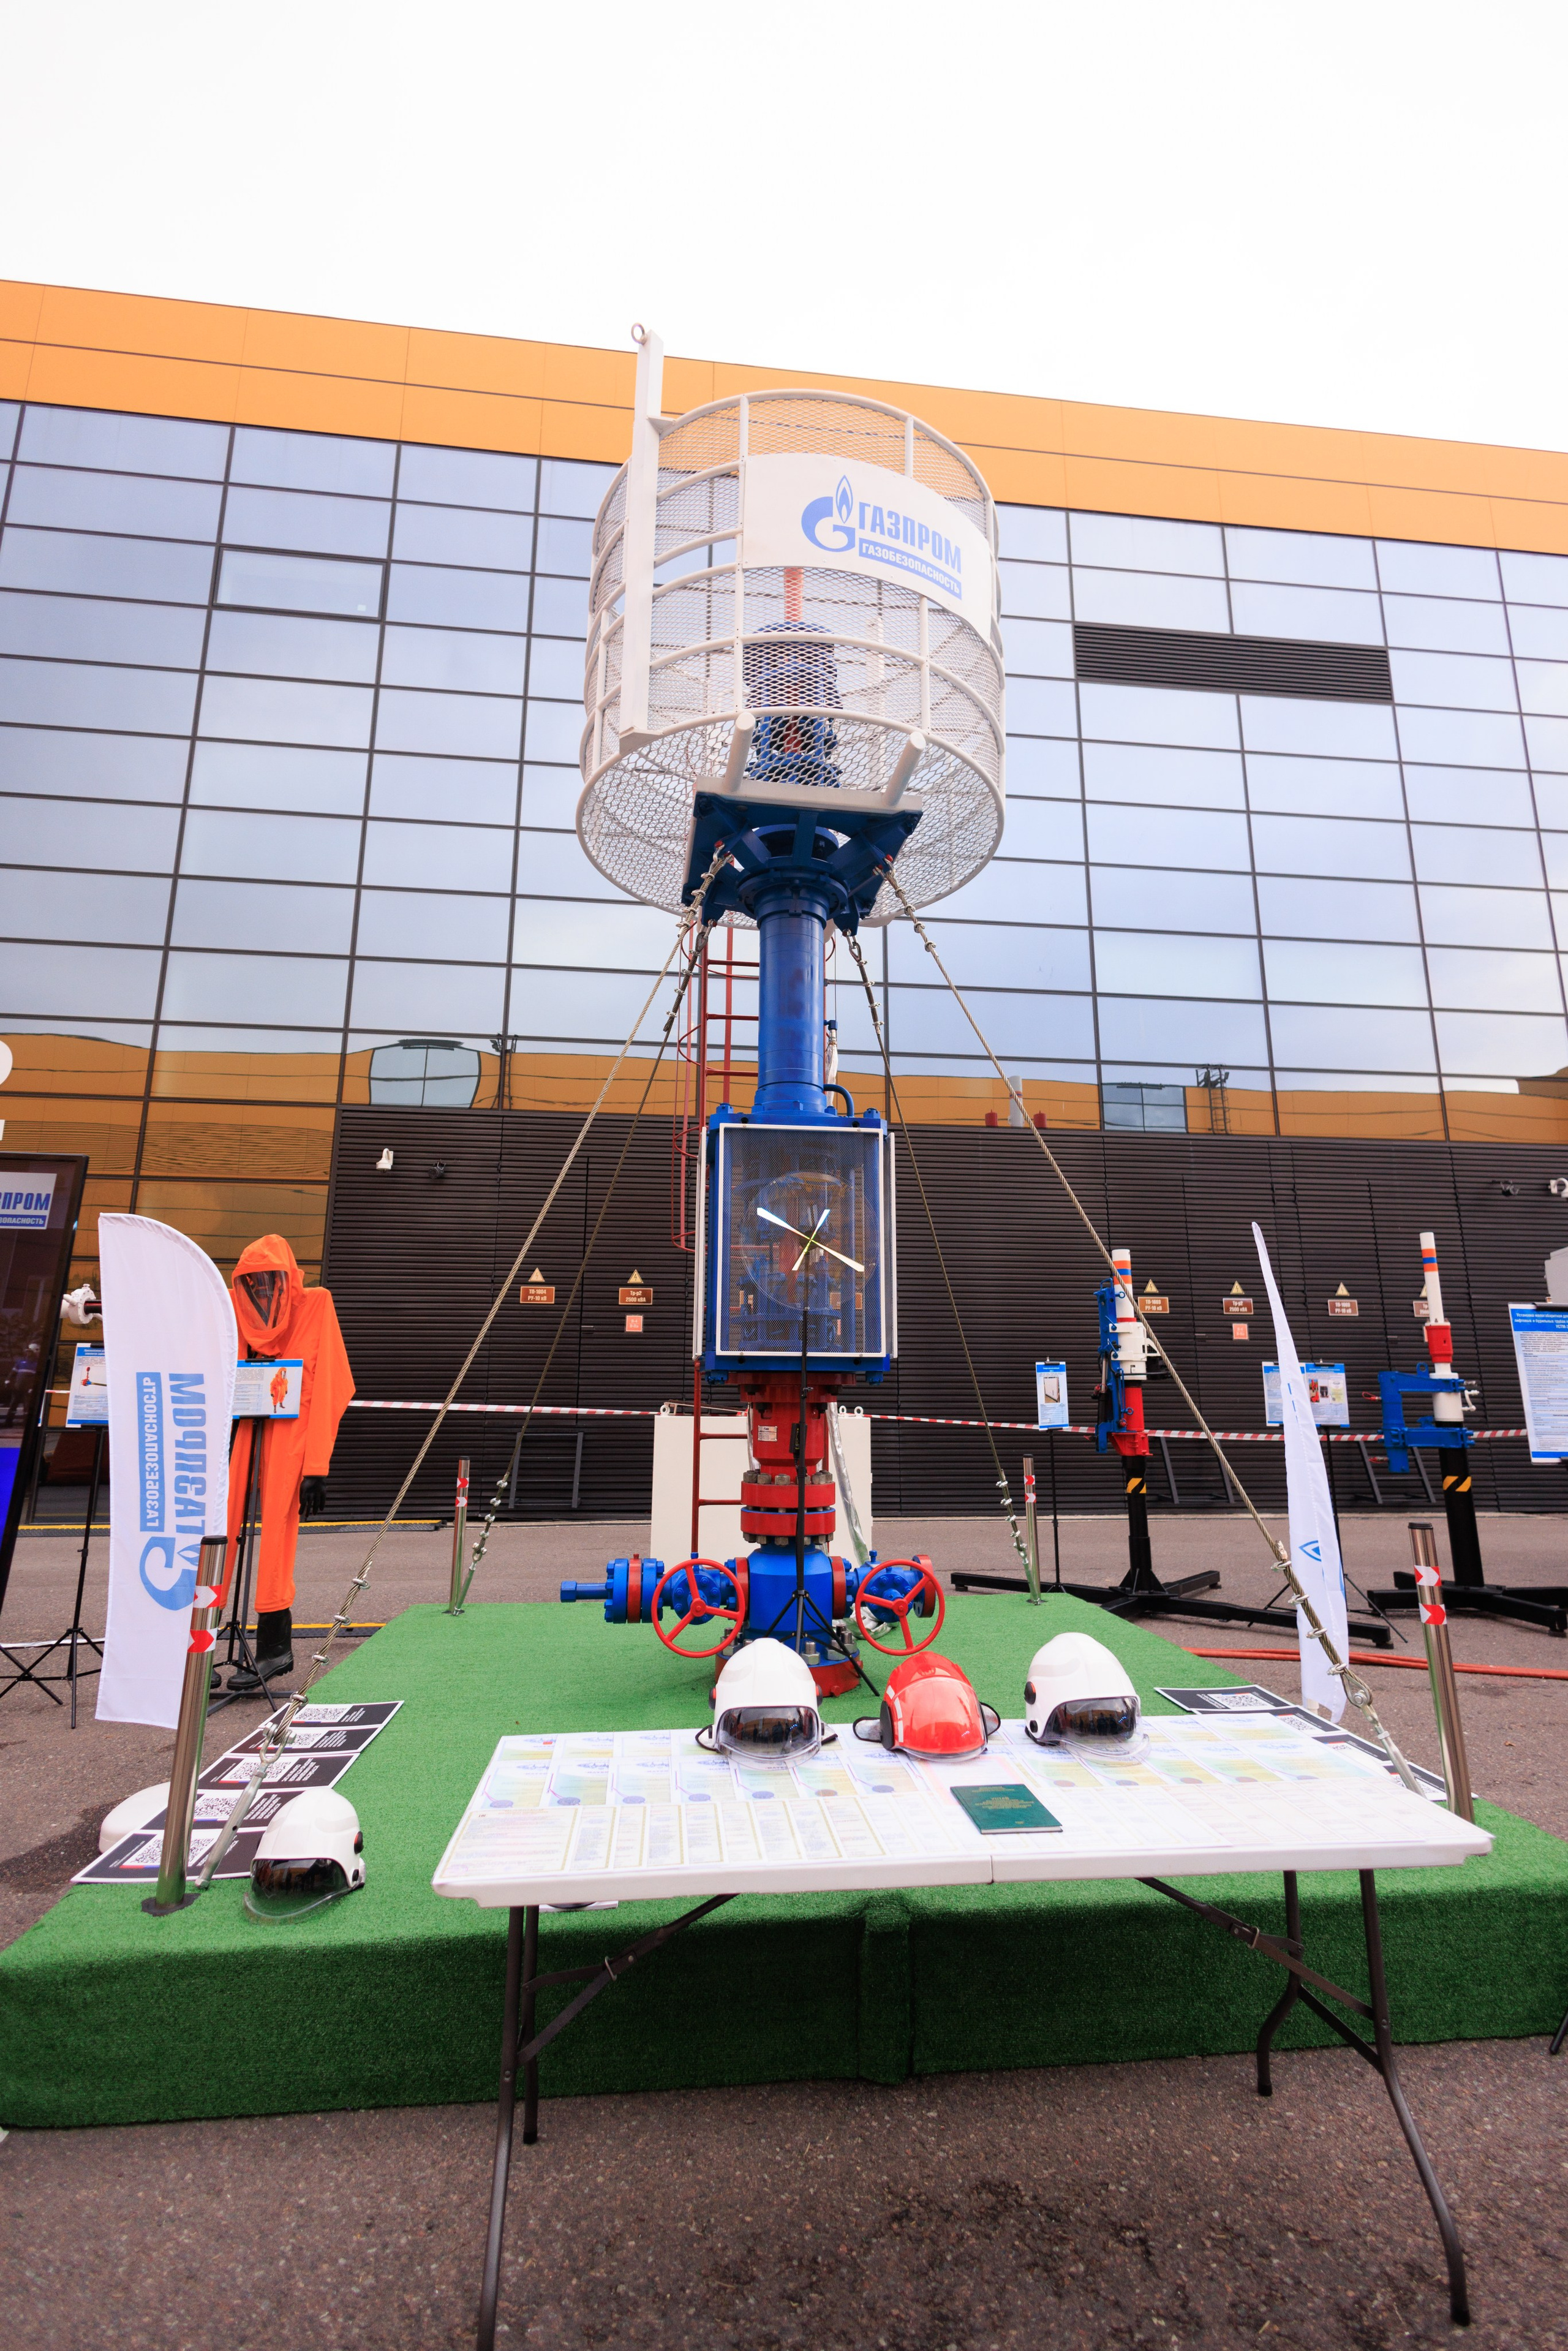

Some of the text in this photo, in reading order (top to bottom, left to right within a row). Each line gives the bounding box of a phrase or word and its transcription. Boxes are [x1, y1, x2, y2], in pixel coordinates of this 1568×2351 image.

[859, 501, 962, 575] ГАЗПРОМ
[862, 543, 960, 594] ГАЗОБЕЗОПАСНОСТЬ
[0, 1192, 51, 1210] ПРОМ
